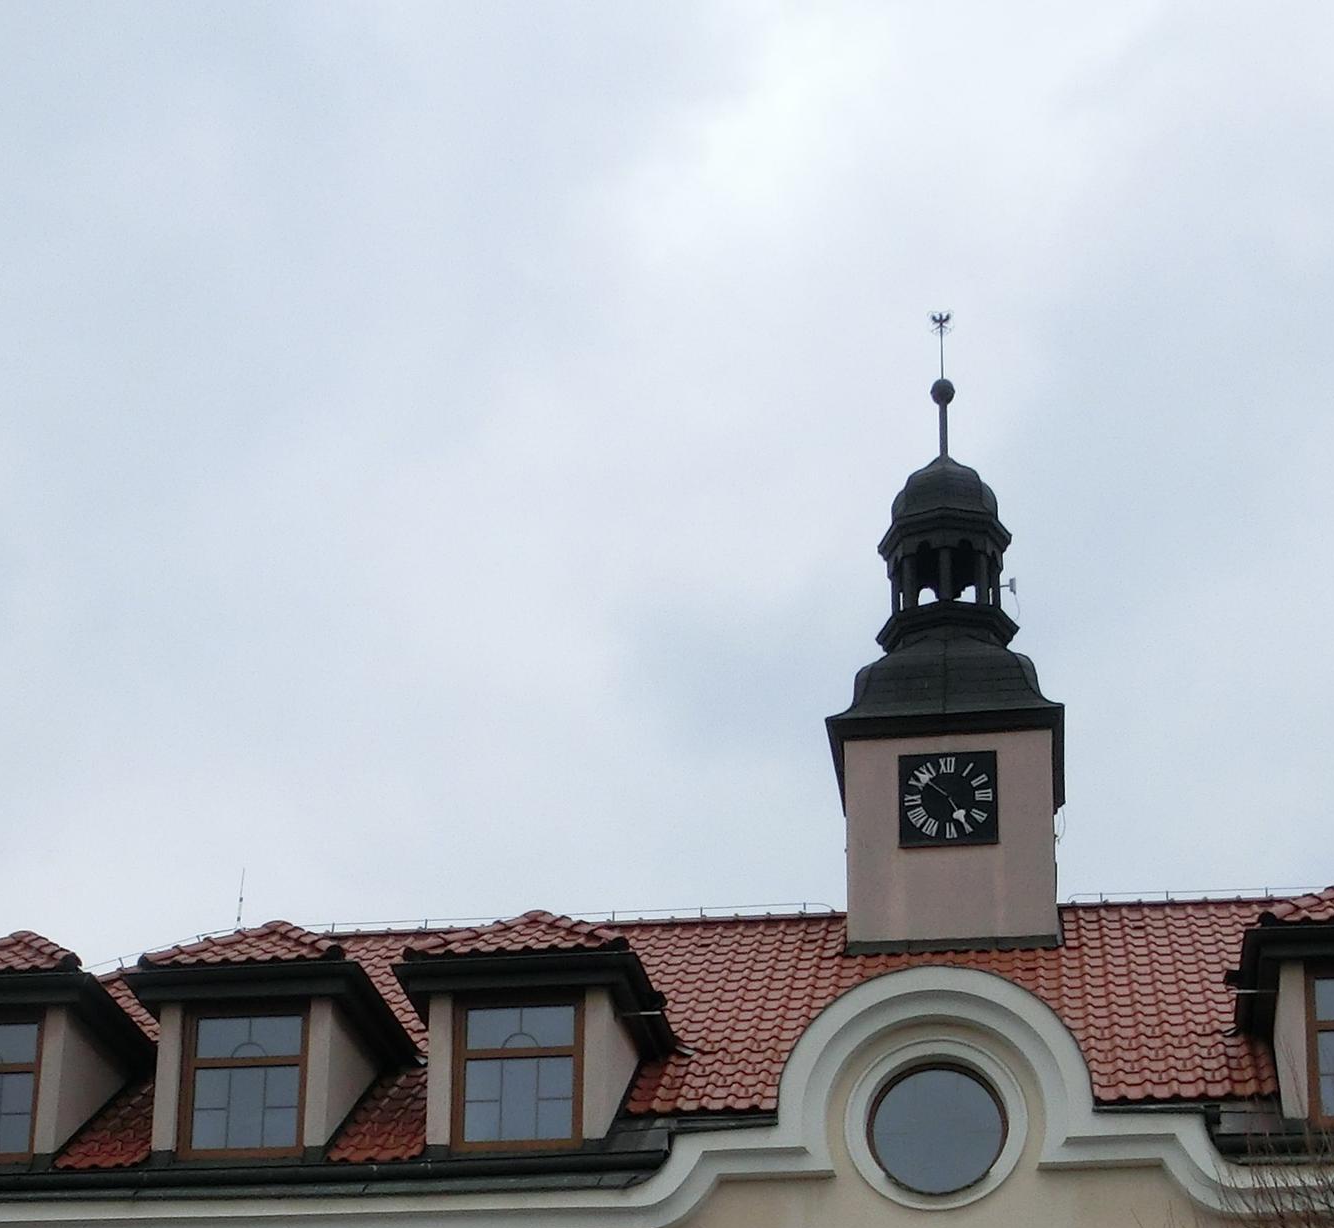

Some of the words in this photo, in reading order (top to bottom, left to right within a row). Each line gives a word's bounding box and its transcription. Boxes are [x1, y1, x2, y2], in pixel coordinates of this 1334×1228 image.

[939, 757, 956, 774] XII
[962, 762, 974, 777] I
[971, 773, 989, 788] II
[904, 794, 922, 806] IX
[975, 788, 993, 802] III
[907, 806, 929, 828] VIII
[921, 817, 939, 837] VII
[946, 822, 958, 838] VI
